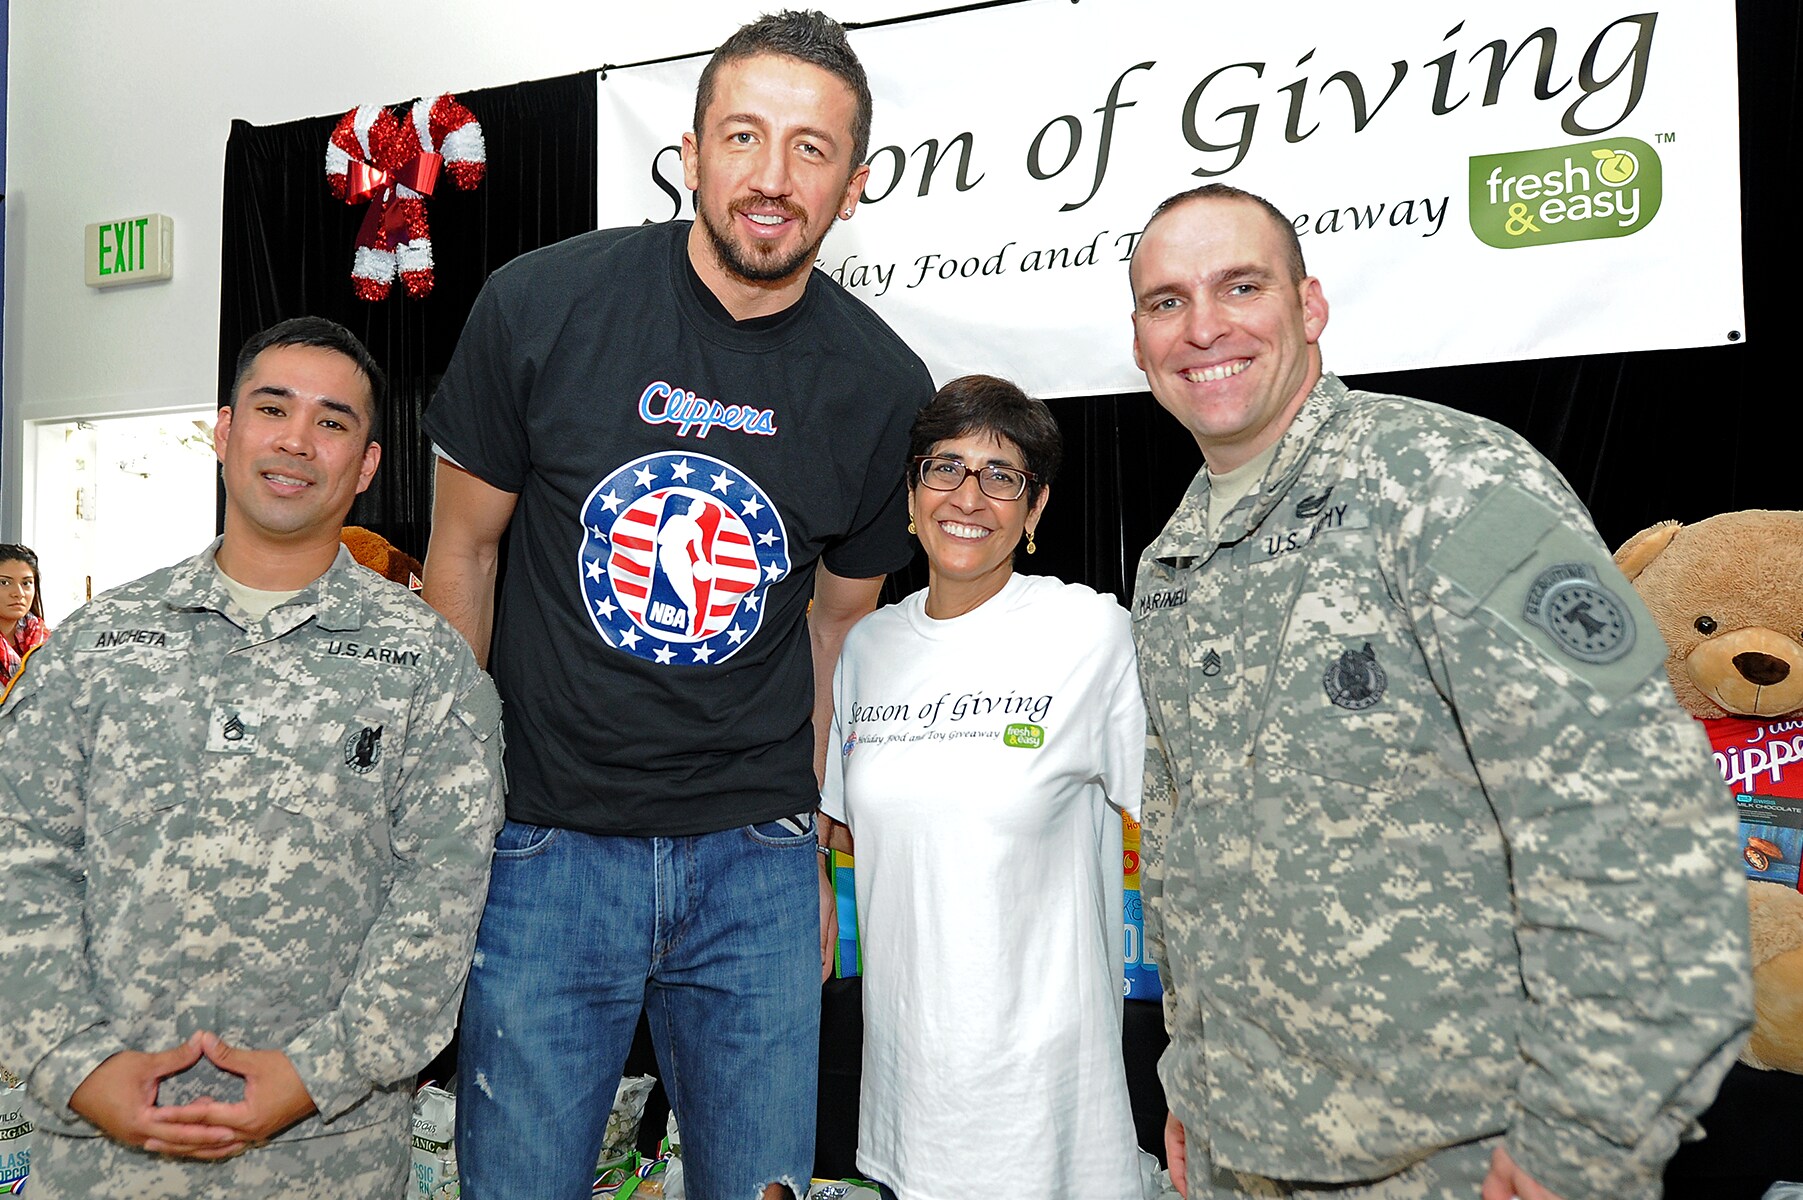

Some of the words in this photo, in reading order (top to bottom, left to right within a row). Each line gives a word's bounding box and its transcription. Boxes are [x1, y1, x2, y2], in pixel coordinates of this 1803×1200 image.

[642, 130, 985, 225] Son
[1026, 60, 1157, 213] of
[1181, 12, 1659, 177] Giving
[1486, 157, 1590, 205] fresh
[99, 217, 150, 276] EXIT
[907, 241, 1016, 288] Food
[1019, 230, 1109, 272] and
[1292, 196, 1450, 238] eaway
[638, 380, 778, 439] Clippers
[649, 600, 687, 630] NBA
[96, 629, 167, 648] ANCHETA
[848, 701, 910, 725] Season
[918, 692, 951, 729] of
[950, 690, 1053, 723] Giving
[948, 730, 1000, 742] Giveaway
[1007, 726, 1030, 738] fresh
[1755, 804, 1802, 813] CHOCOLATE
[0, 1111, 18, 1122] ILD
[412, 1136, 436, 1152] ANIC
